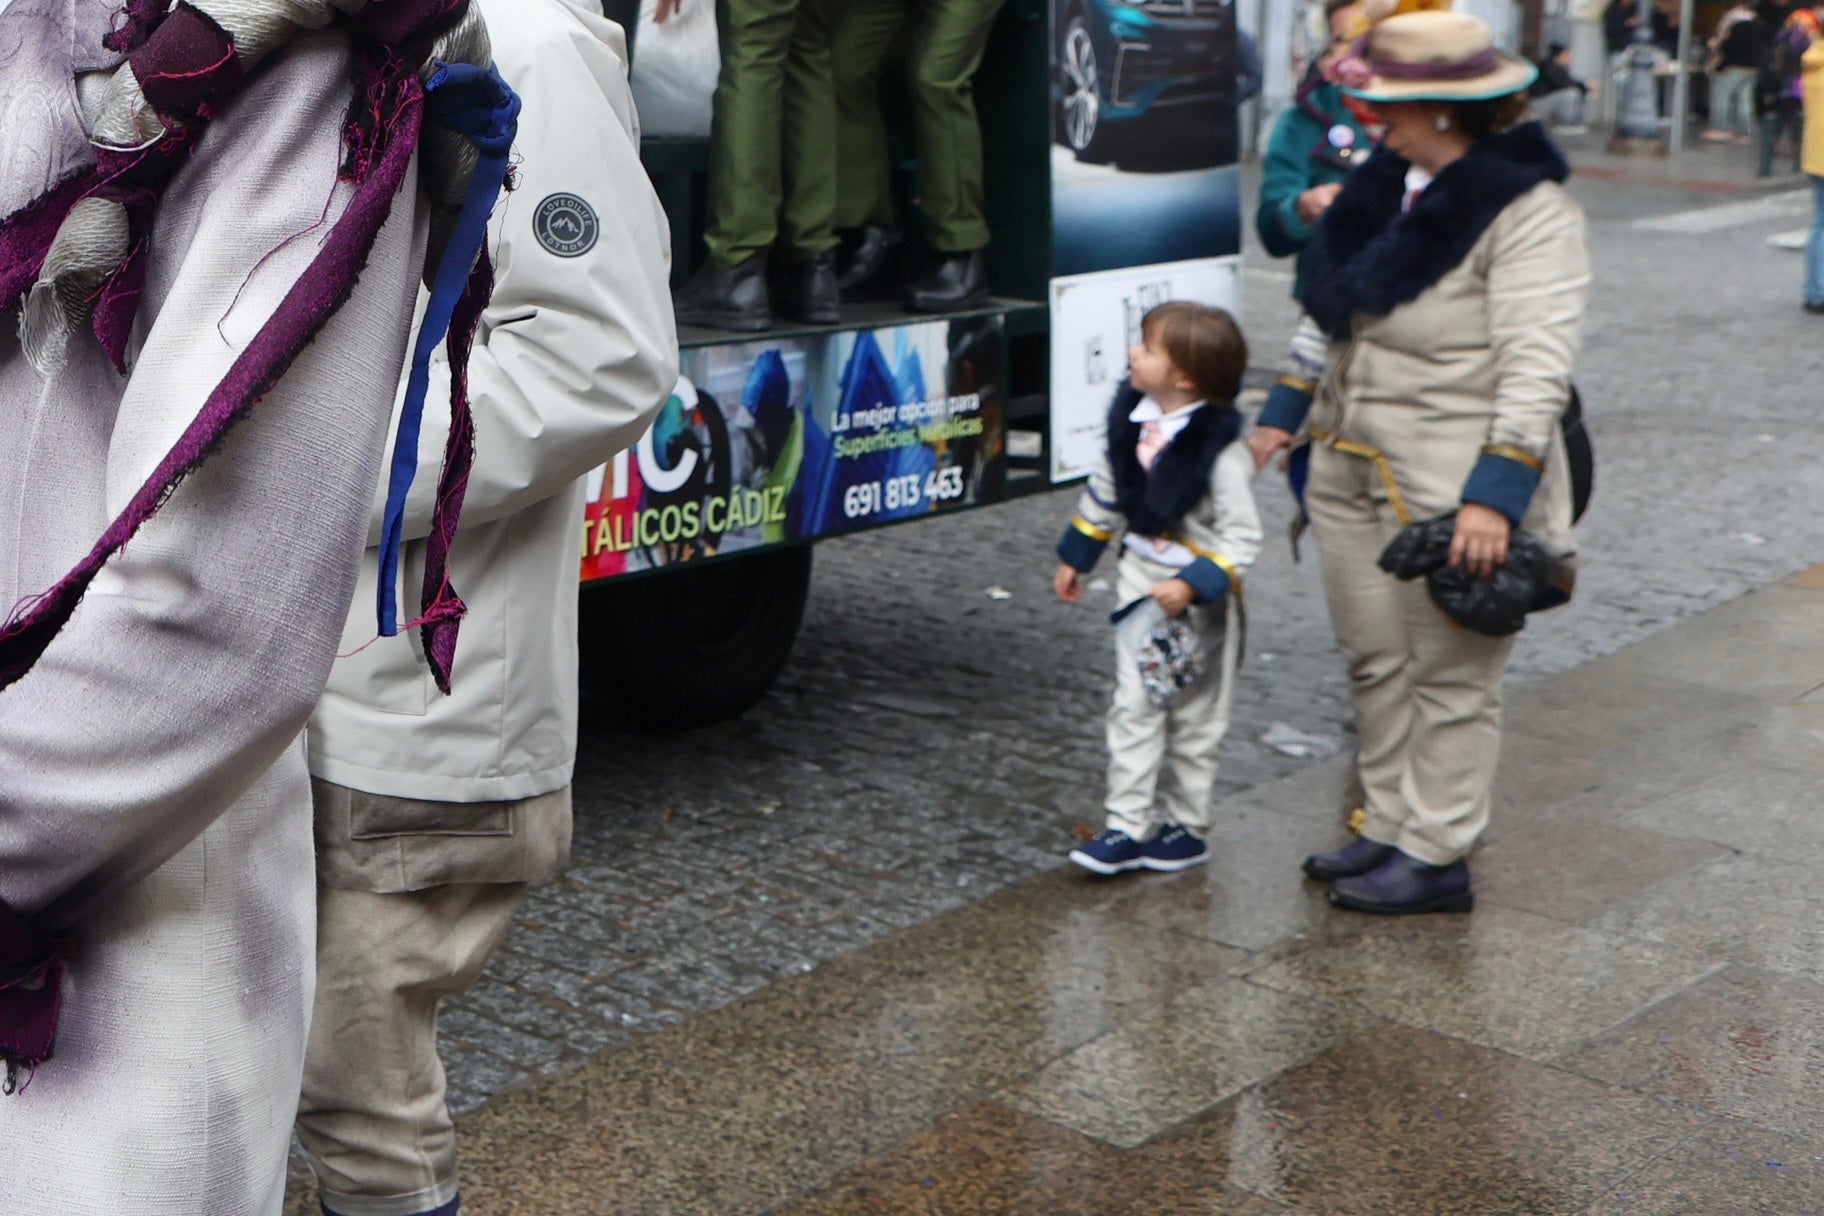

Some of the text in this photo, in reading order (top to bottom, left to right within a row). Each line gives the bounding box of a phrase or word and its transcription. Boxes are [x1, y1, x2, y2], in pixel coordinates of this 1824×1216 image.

[831, 410, 850, 432] La
[852, 402, 897, 432] mejor
[948, 392, 980, 417] para
[834, 427, 917, 460] Superficies
[706, 483, 786, 533] CÁDIZ
[844, 466, 964, 518] 691 813 463
